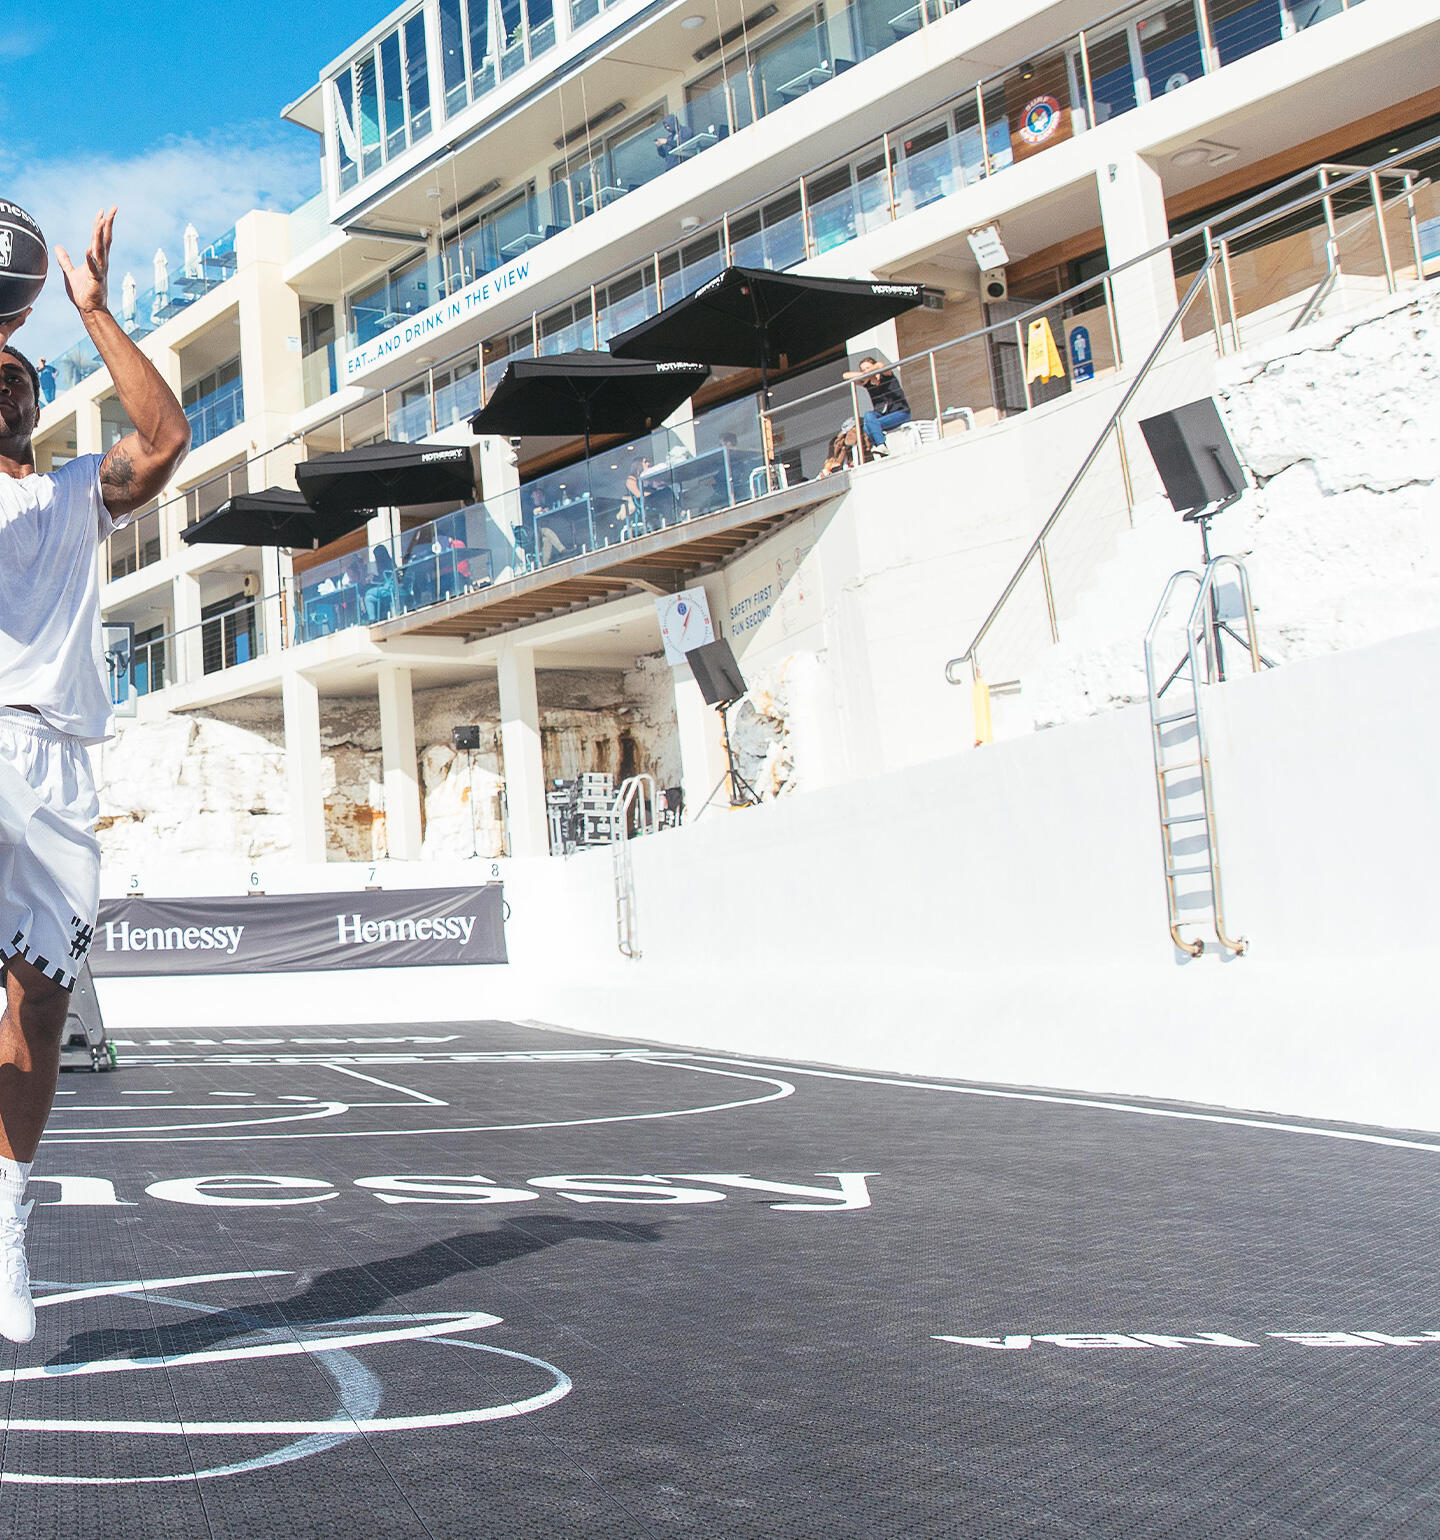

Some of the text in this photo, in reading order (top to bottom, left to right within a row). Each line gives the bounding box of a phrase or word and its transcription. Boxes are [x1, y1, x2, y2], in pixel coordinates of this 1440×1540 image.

[405, 311, 444, 343] DRINK
[447, 301, 461, 320] IN
[464, 284, 490, 310] THE
[494, 261, 530, 293] VIEW
[730, 585, 773, 620] SAFETY FIRST
[731, 605, 773, 637] FUN SECOND
[130, 874, 140, 889] 5
[250, 871, 260, 886] 6
[368, 867, 377, 882] 7
[491, 863, 500, 877] 8
[105, 921, 245, 955] Hennessy
[336, 913, 477, 945] Hennessy
